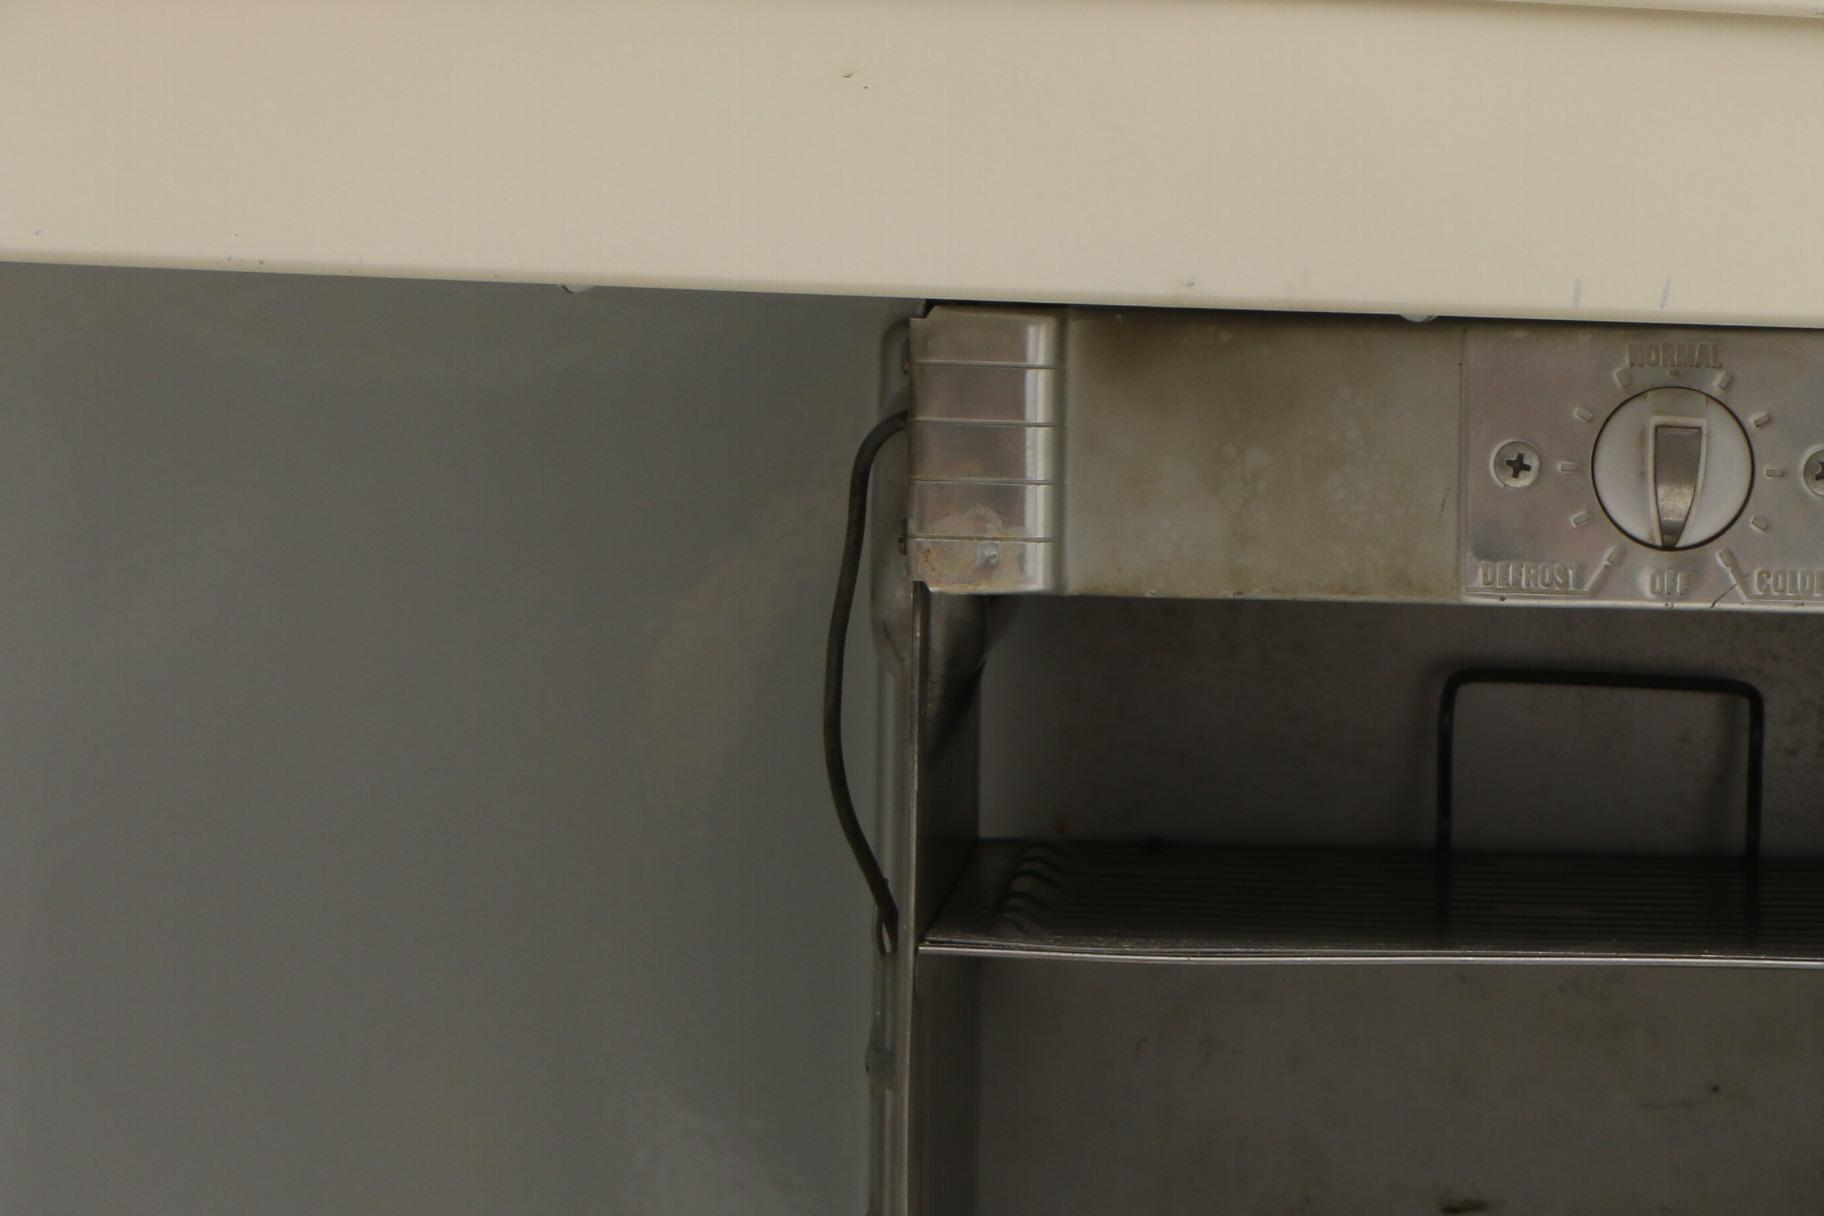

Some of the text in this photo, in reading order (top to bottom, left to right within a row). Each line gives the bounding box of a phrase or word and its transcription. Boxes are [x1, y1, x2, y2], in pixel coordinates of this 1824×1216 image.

[1625, 342, 1722, 370] NORMAL
[1478, 560, 1583, 591] DEFROST
[1648, 567, 1690, 597] OFF
